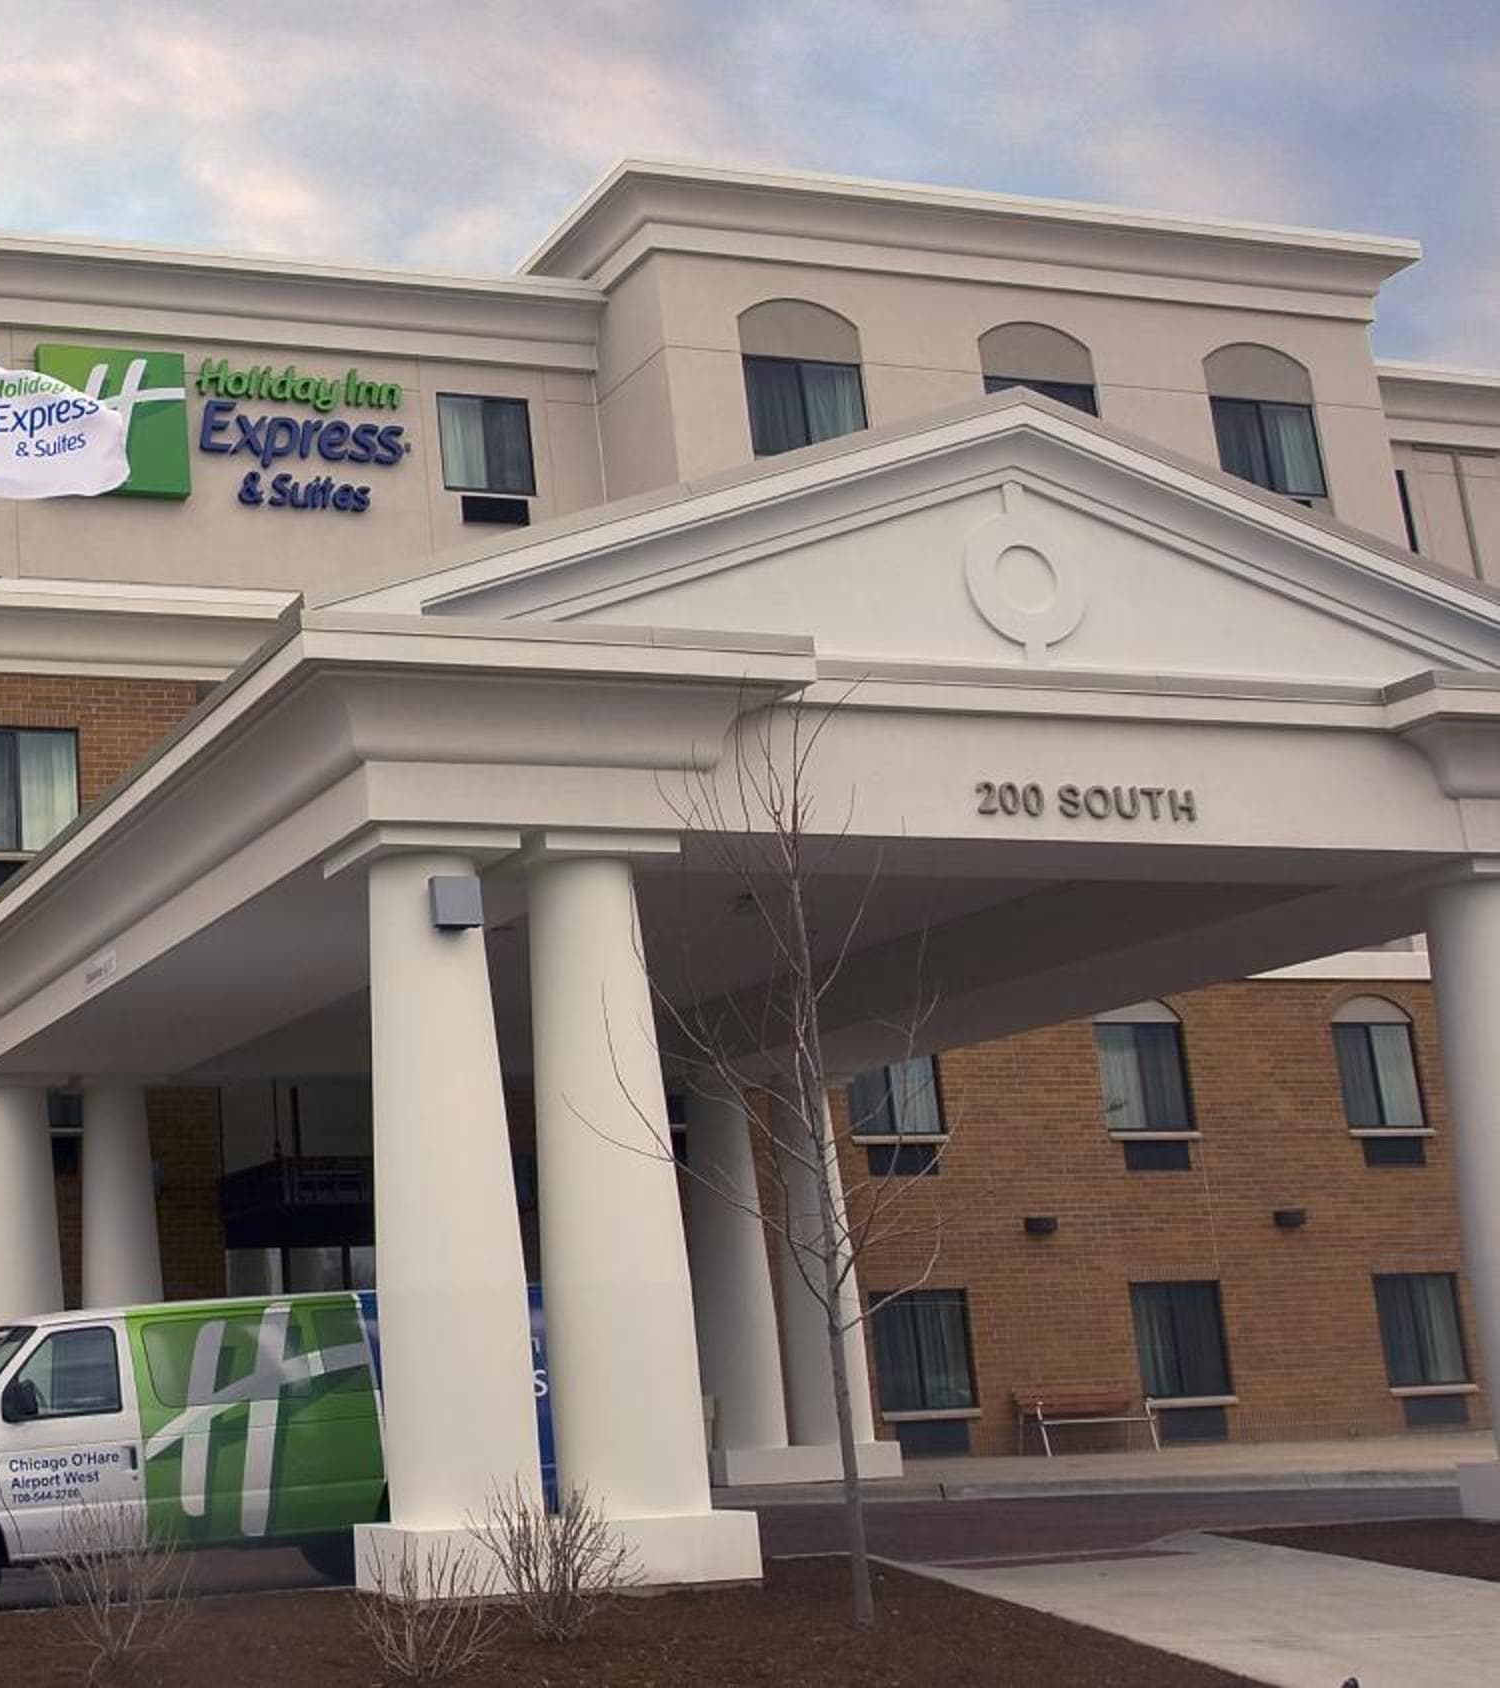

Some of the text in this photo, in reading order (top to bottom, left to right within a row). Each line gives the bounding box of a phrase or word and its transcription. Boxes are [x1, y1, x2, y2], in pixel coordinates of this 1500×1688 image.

[196, 357, 404, 412] Holiday Inn
[15, 433, 87, 457] & Suites
[200, 399, 406, 469] Express
[238, 471, 371, 512] & Suites
[974, 781, 1198, 823] 200 SOUTH
[9, 1451, 120, 1472] Chicago O'Hare
[11, 1470, 100, 1490] Airport West
